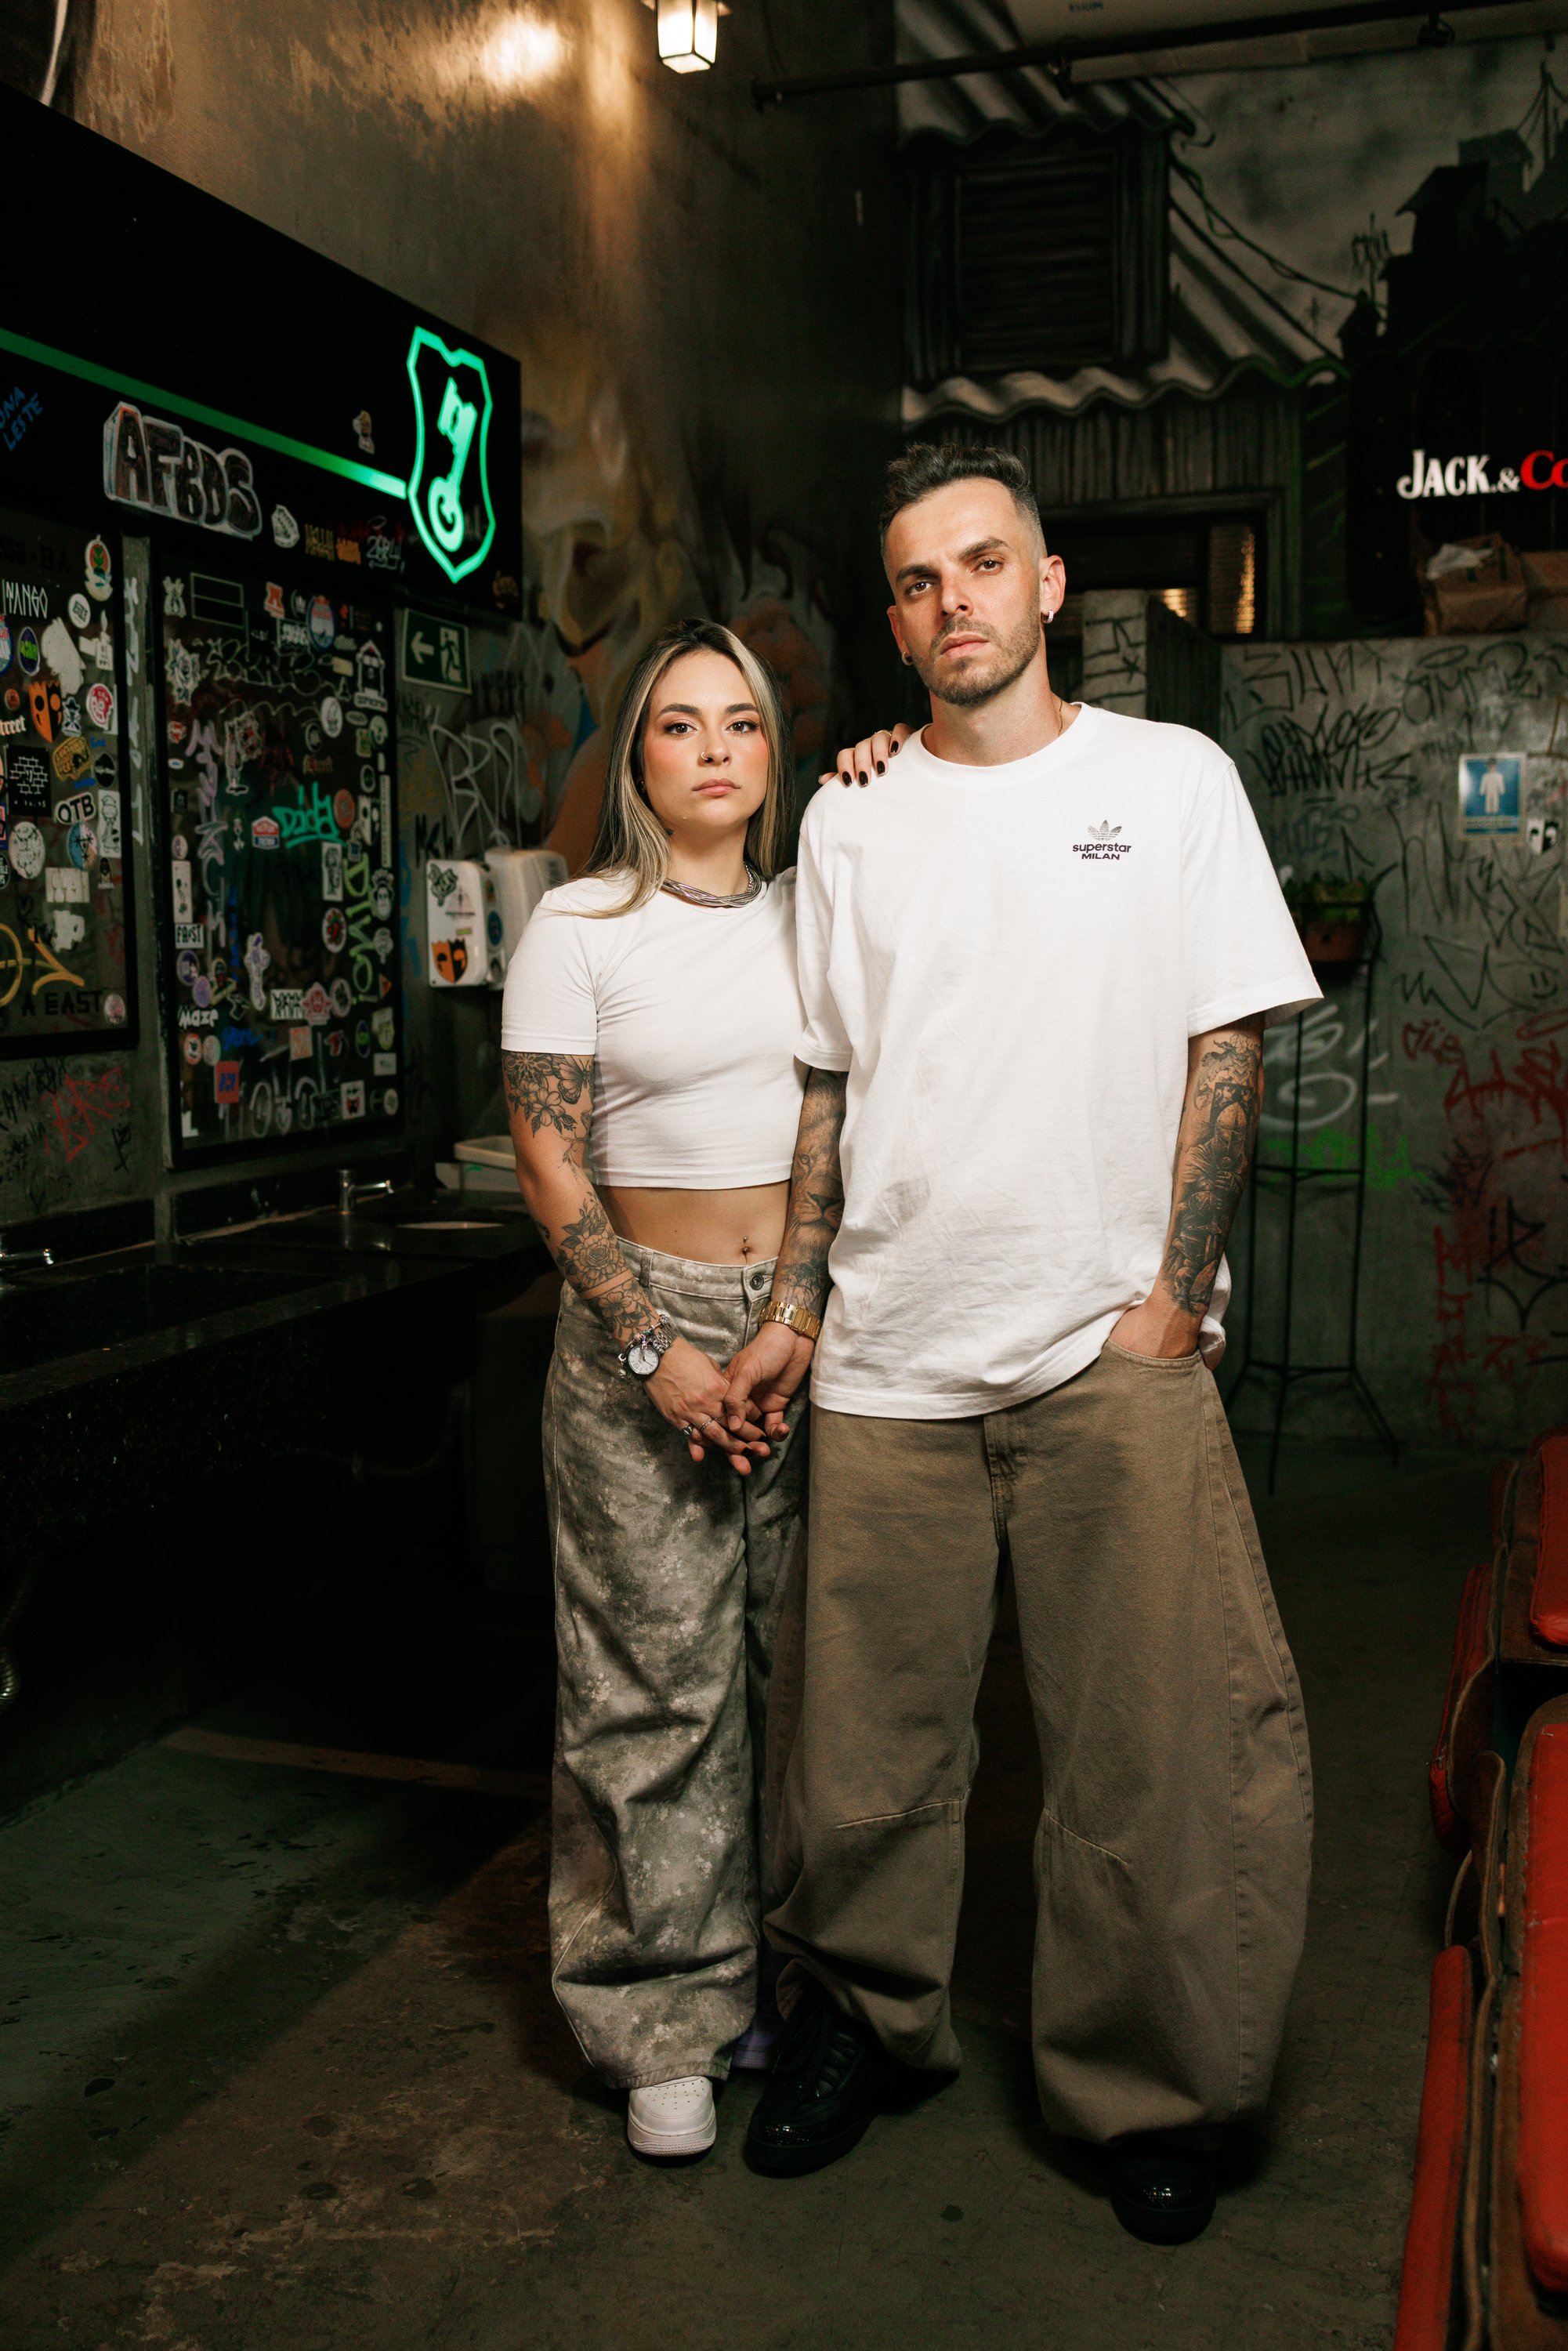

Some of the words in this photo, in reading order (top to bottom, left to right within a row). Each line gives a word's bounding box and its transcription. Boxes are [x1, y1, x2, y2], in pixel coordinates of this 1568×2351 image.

[58, 795, 94, 823] OTB
[1072, 842, 1132, 853] superstar
[45, 991, 103, 1016] EAST
